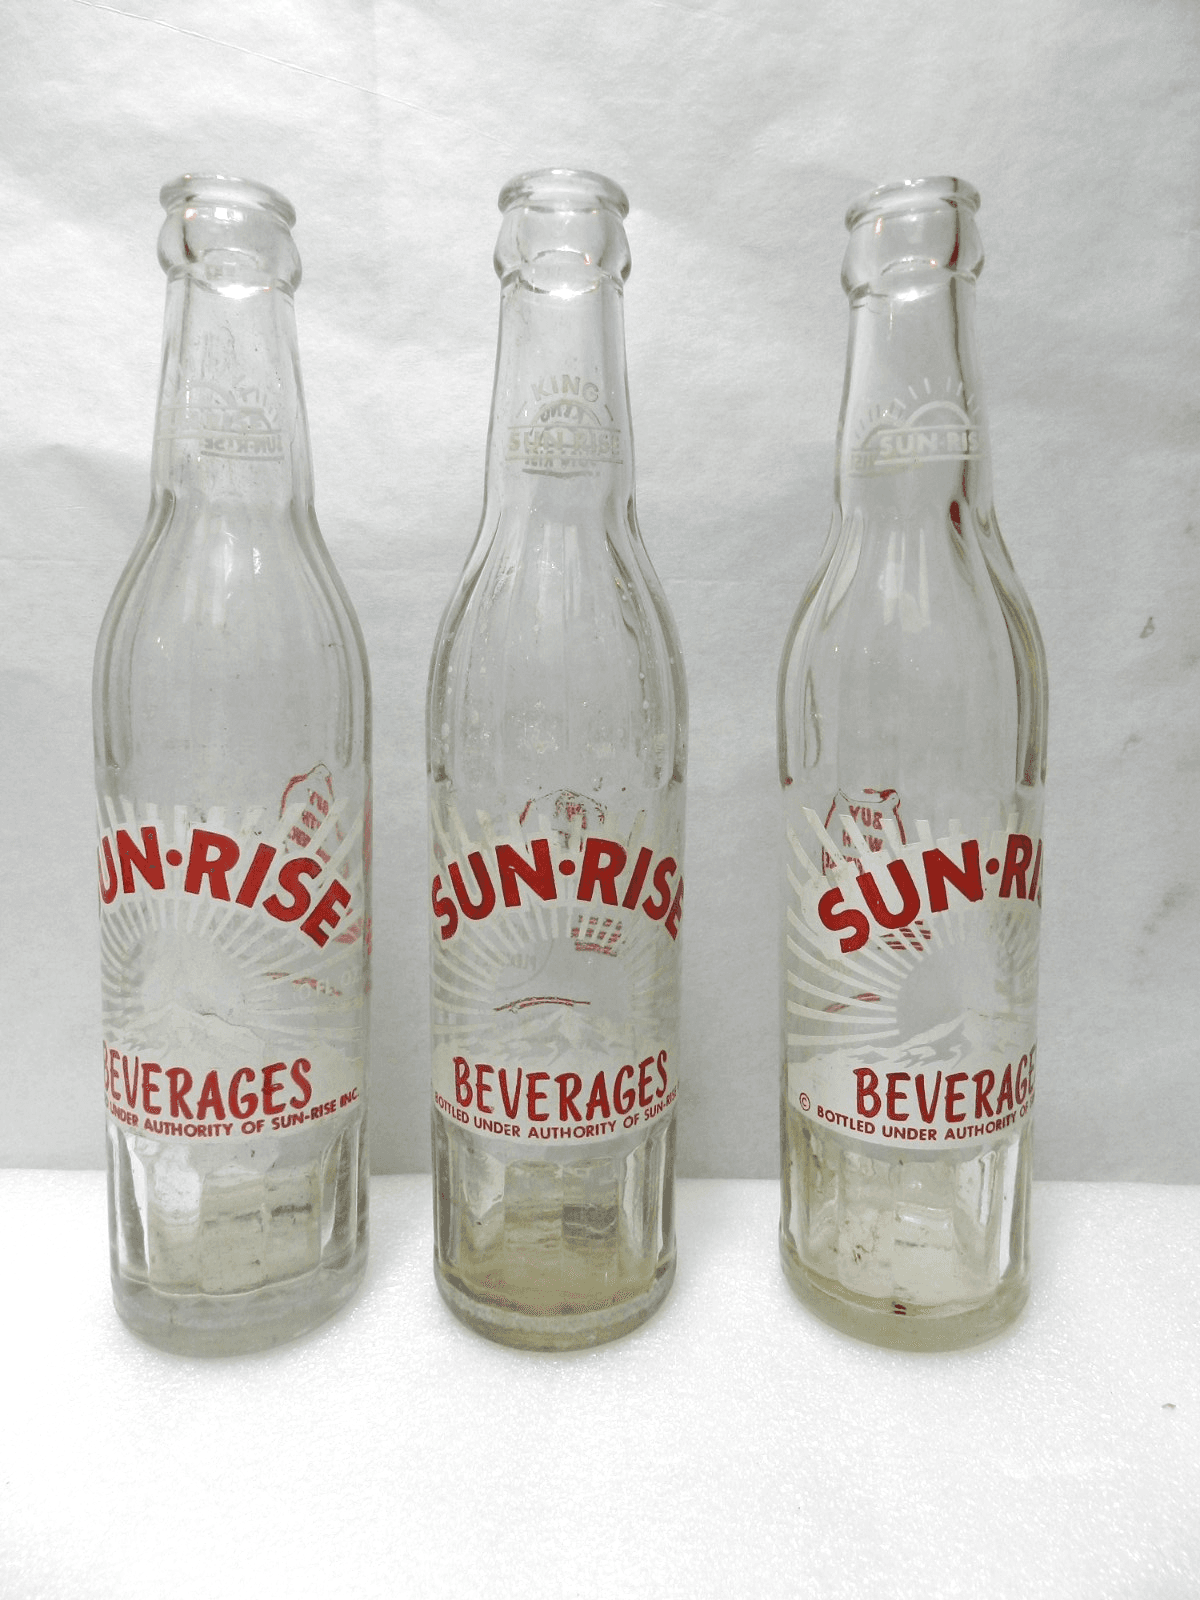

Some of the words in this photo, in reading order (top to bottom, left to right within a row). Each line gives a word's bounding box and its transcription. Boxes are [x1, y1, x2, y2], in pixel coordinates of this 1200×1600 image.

[531, 374, 600, 403] KING
[453, 1050, 668, 1123] BEVERAGES
[144, 1116, 233, 1138] AUTHORITY
[241, 1120, 265, 1135] OF
[271, 1098, 337, 1131] SUN-RISE
[474, 1116, 521, 1138] UNDER
[528, 1120, 616, 1140] AUTHORITY
[623, 1113, 640, 1129] OF
[817, 1105, 876, 1134] BOTTLED
[882, 1124, 938, 1140] UNDER
[944, 1109, 1017, 1140] AUTHORITY
